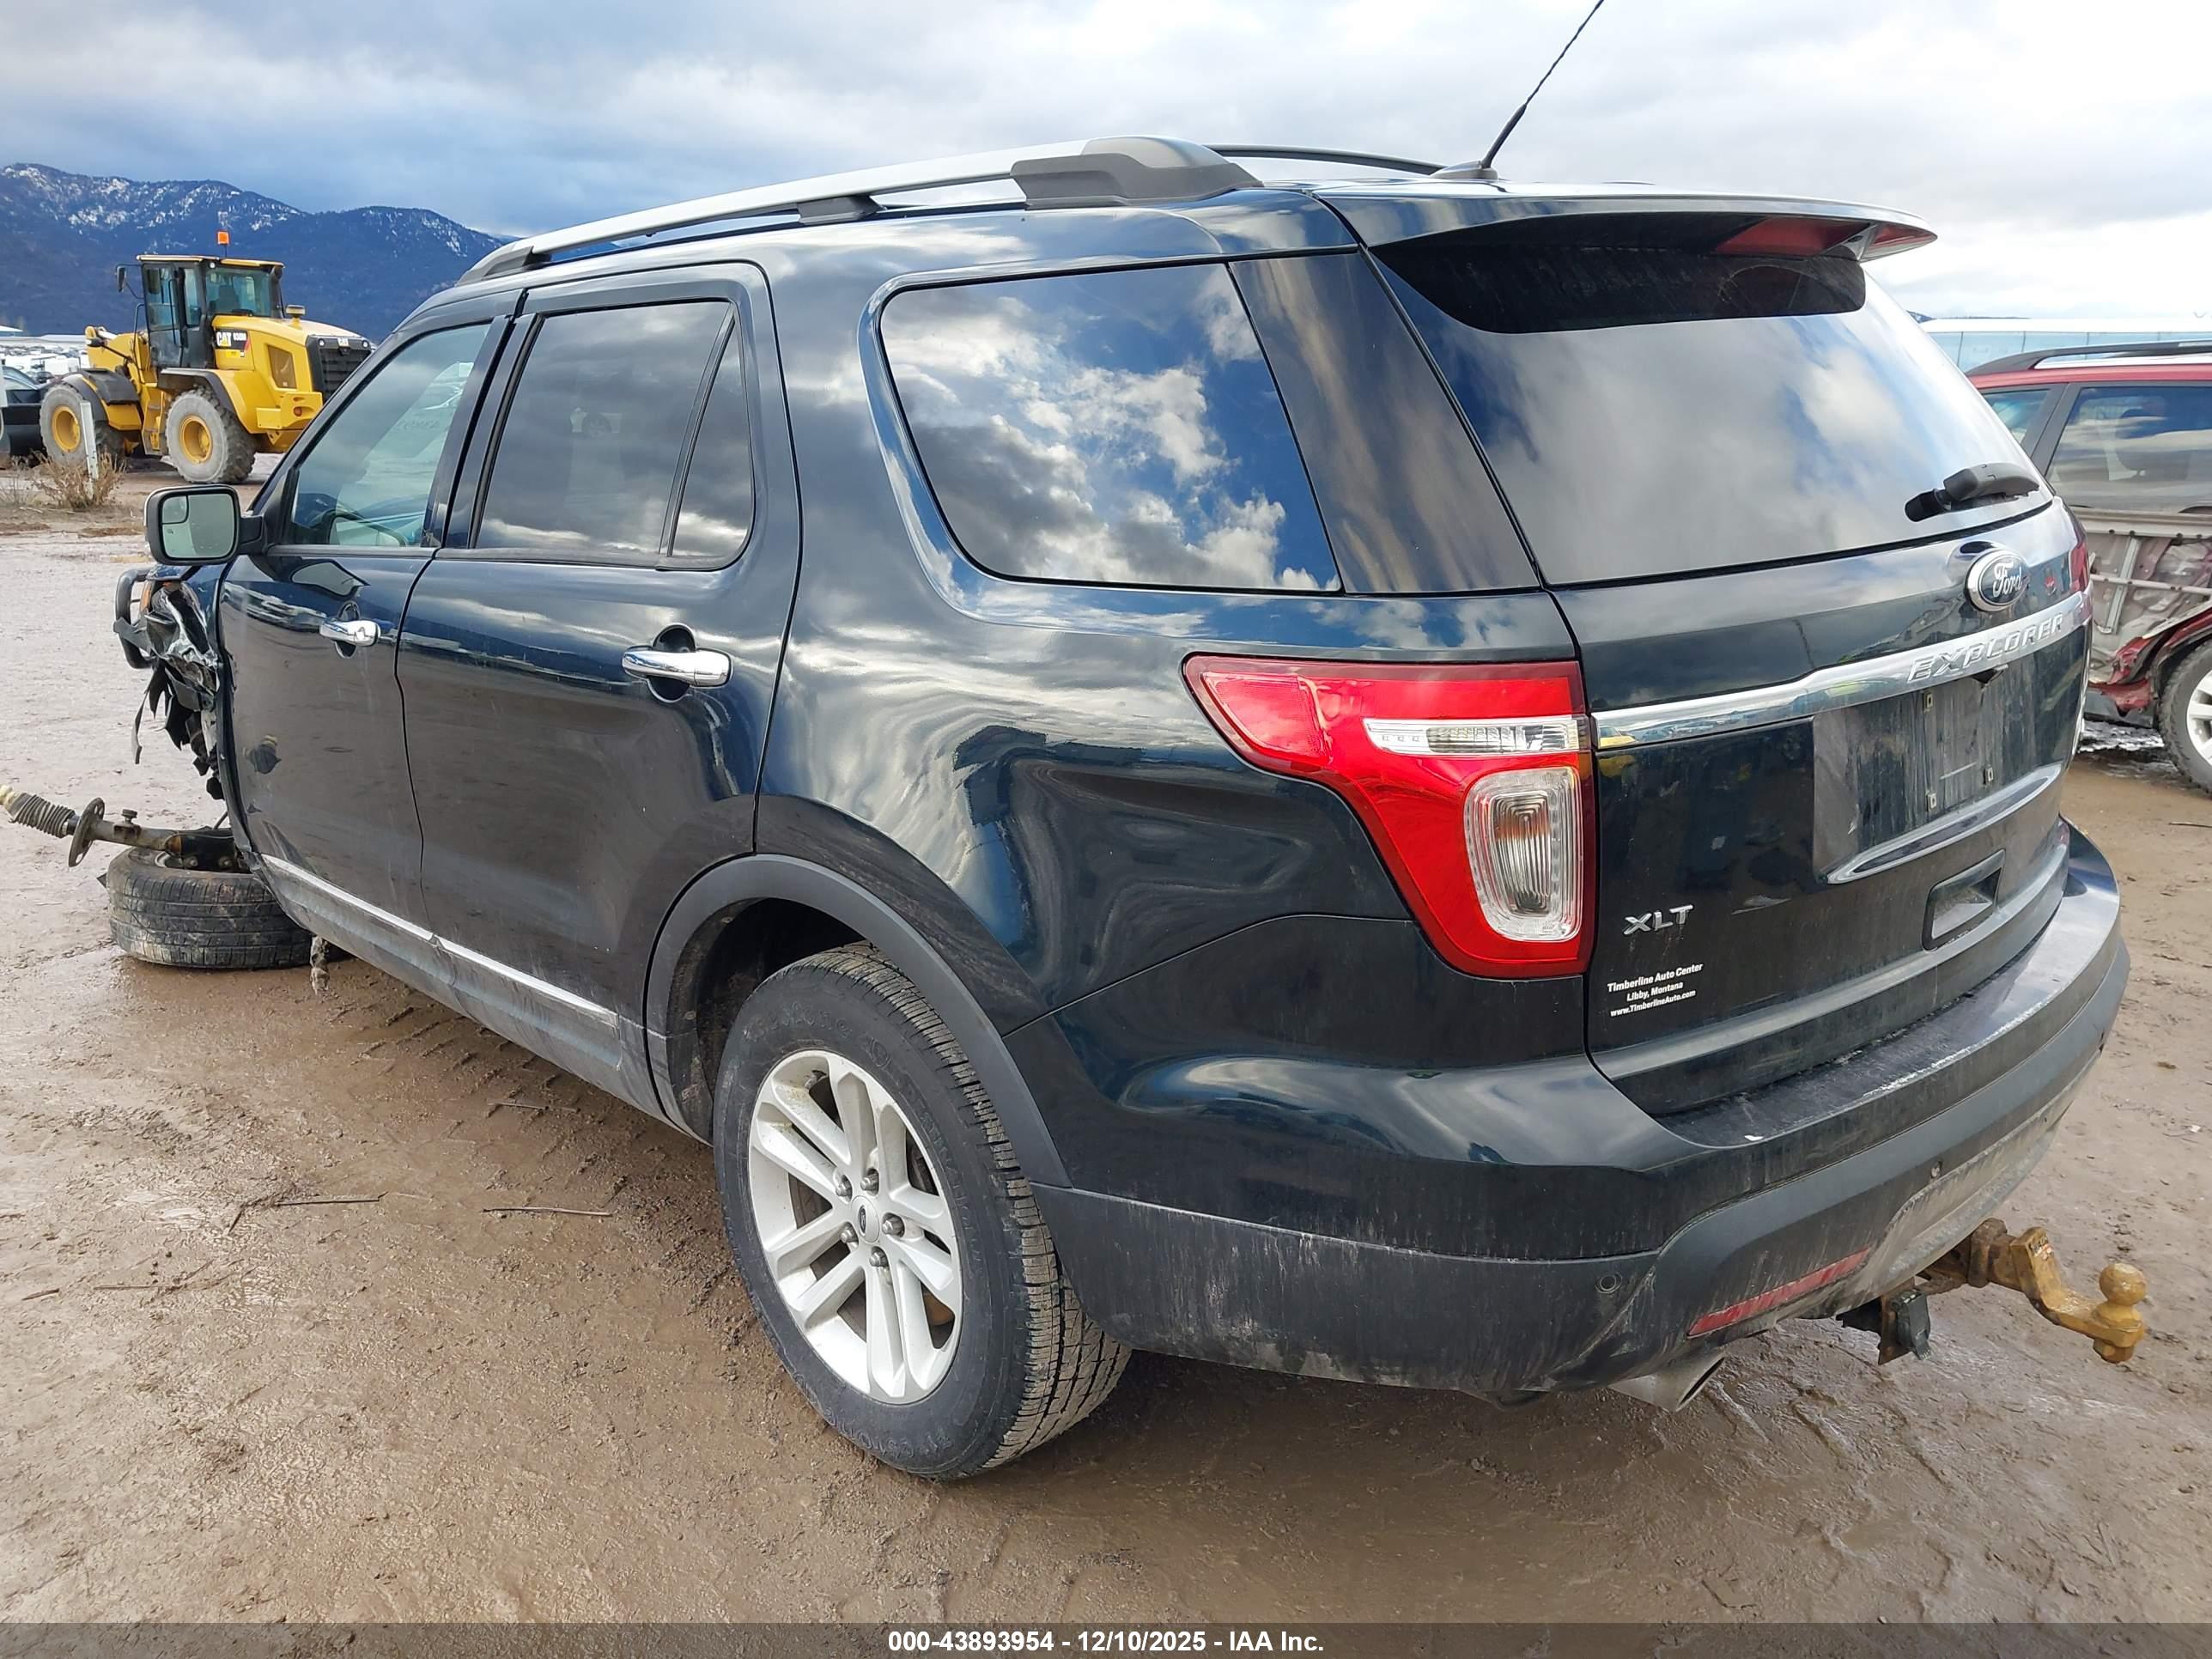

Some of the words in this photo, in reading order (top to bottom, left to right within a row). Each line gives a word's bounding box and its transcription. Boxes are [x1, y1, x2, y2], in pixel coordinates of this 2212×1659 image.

[216, 331, 232, 347] CAT
[1992, 561, 2022, 598] Ford
[1907, 614, 2063, 684] EXPLORER
[1623, 904, 1693, 934] XLT
[1607, 975, 1654, 993] Timberline
[1655, 970, 1675, 982] Auto
[1675, 963, 1704, 976] Center
[1626, 990, 1650, 1002] Libby,
[1650, 981, 1684, 996] Montana
[1610, 990, 1696, 1017] www.TimberlineAuto.com
